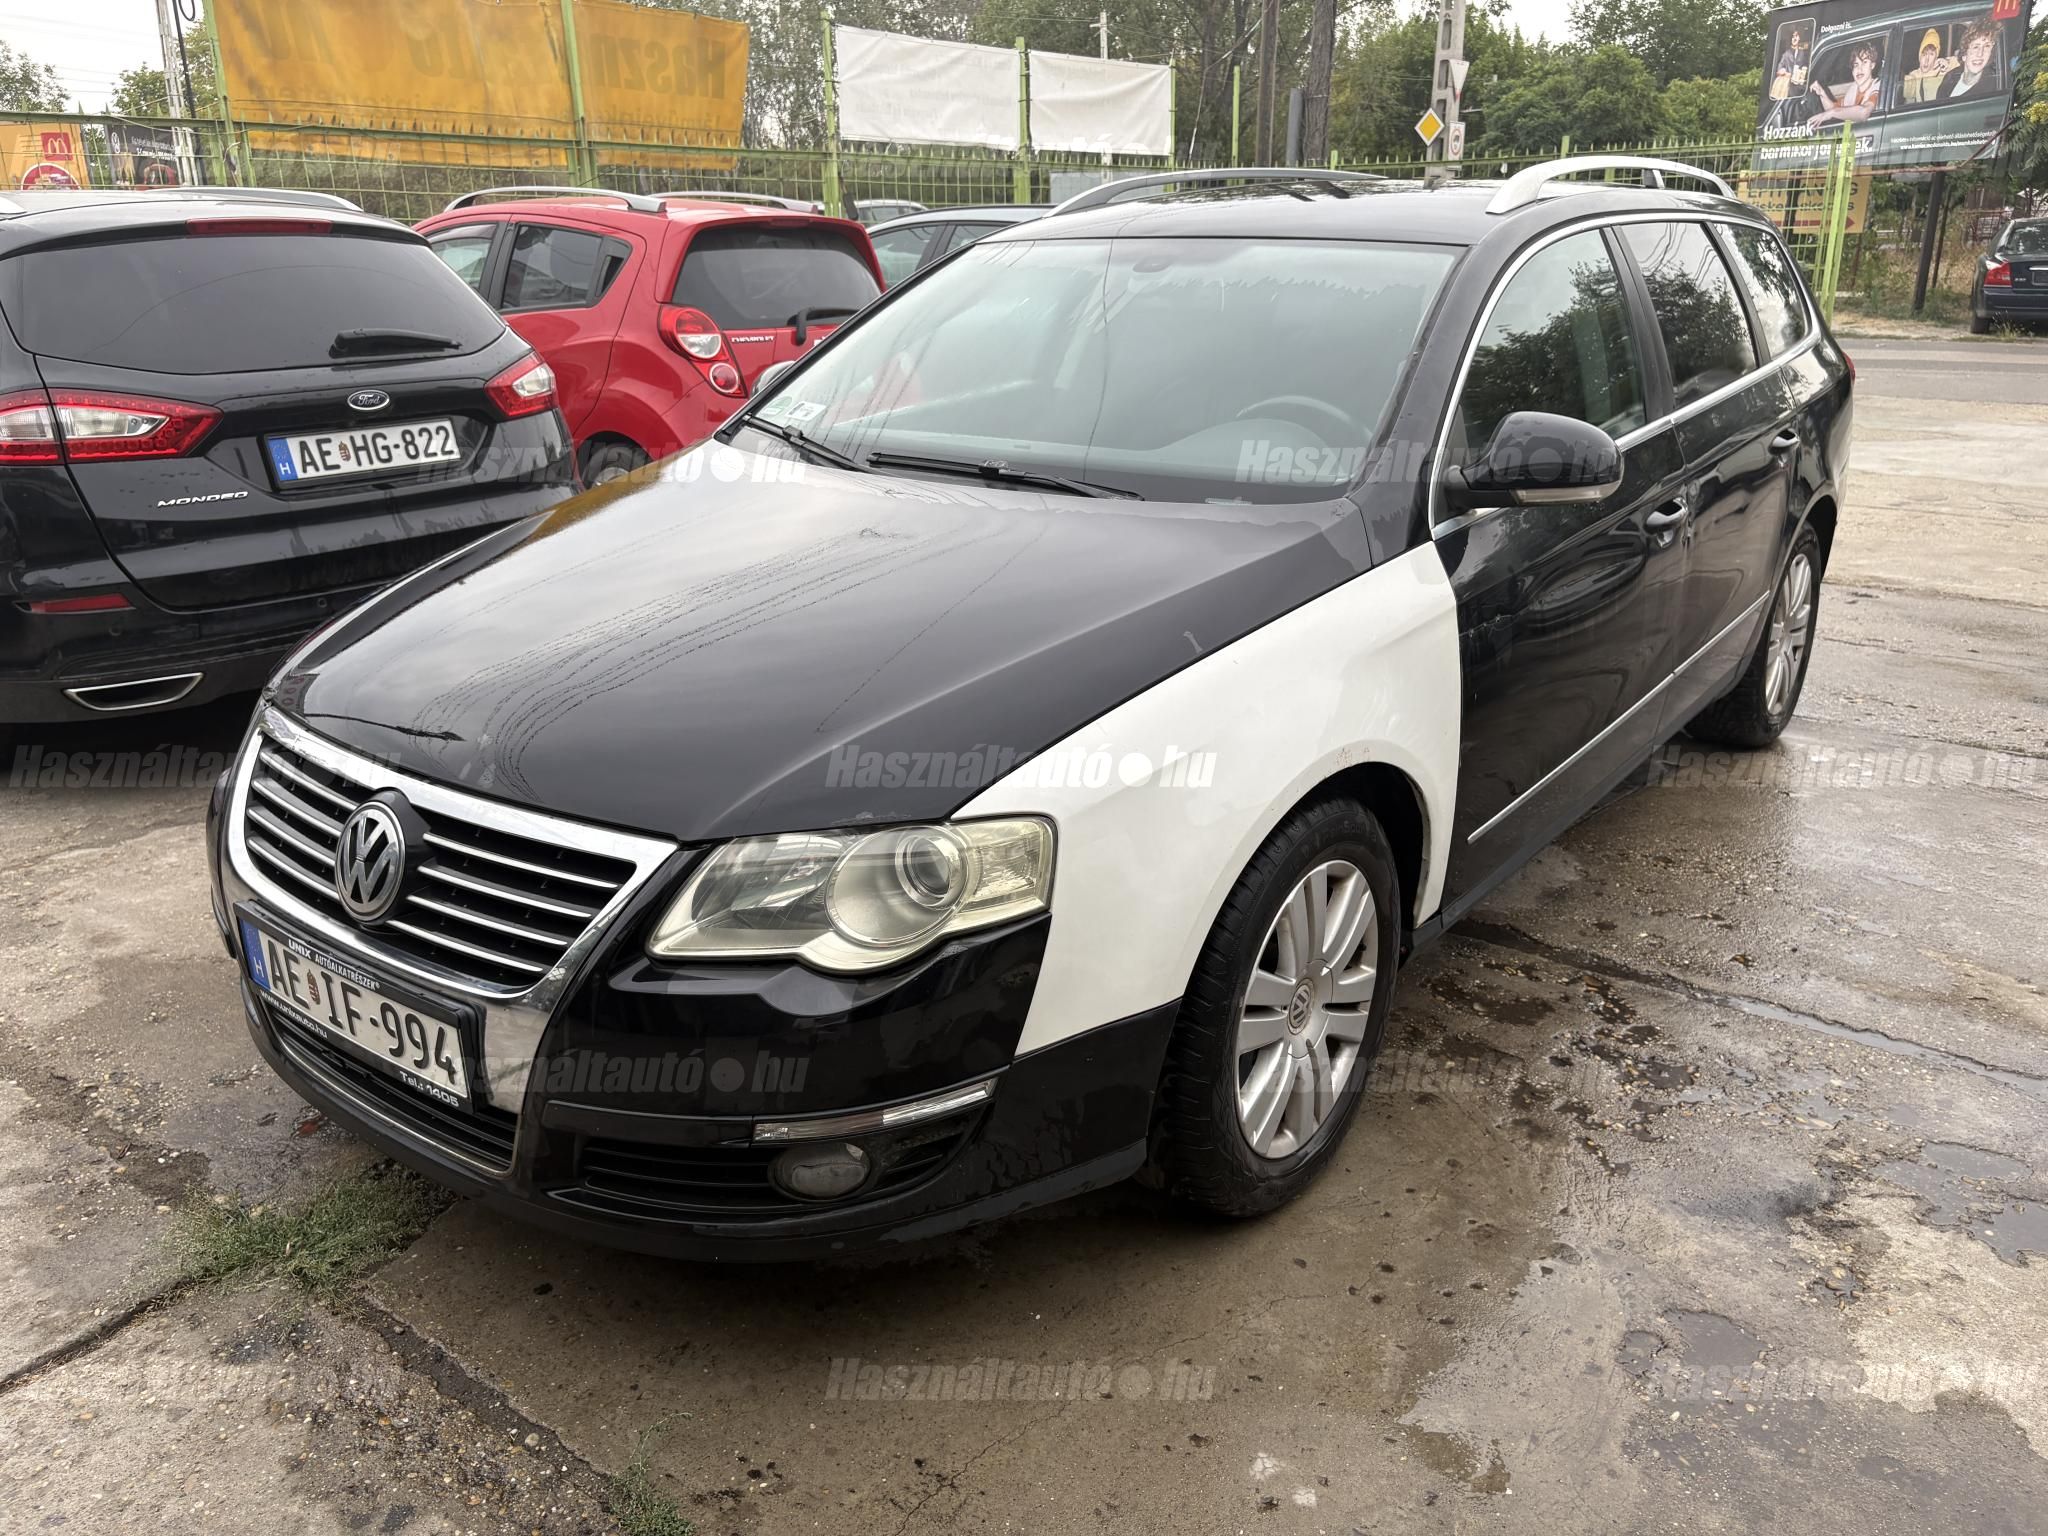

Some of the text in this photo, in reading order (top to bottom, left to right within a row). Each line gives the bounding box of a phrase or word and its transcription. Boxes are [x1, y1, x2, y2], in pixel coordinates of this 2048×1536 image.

[1763, 121, 1814, 140] Hozzánk
[280, 425, 455, 475] H AE HG-822
[156, 490, 249, 508] MONDEO
[288, 939, 312, 959] UNIX
[253, 939, 458, 1085] H AE IF-994
[260, 989, 328, 1039] www.unixauto.hu
[400, 1071, 460, 1108] Tel.: 1405
